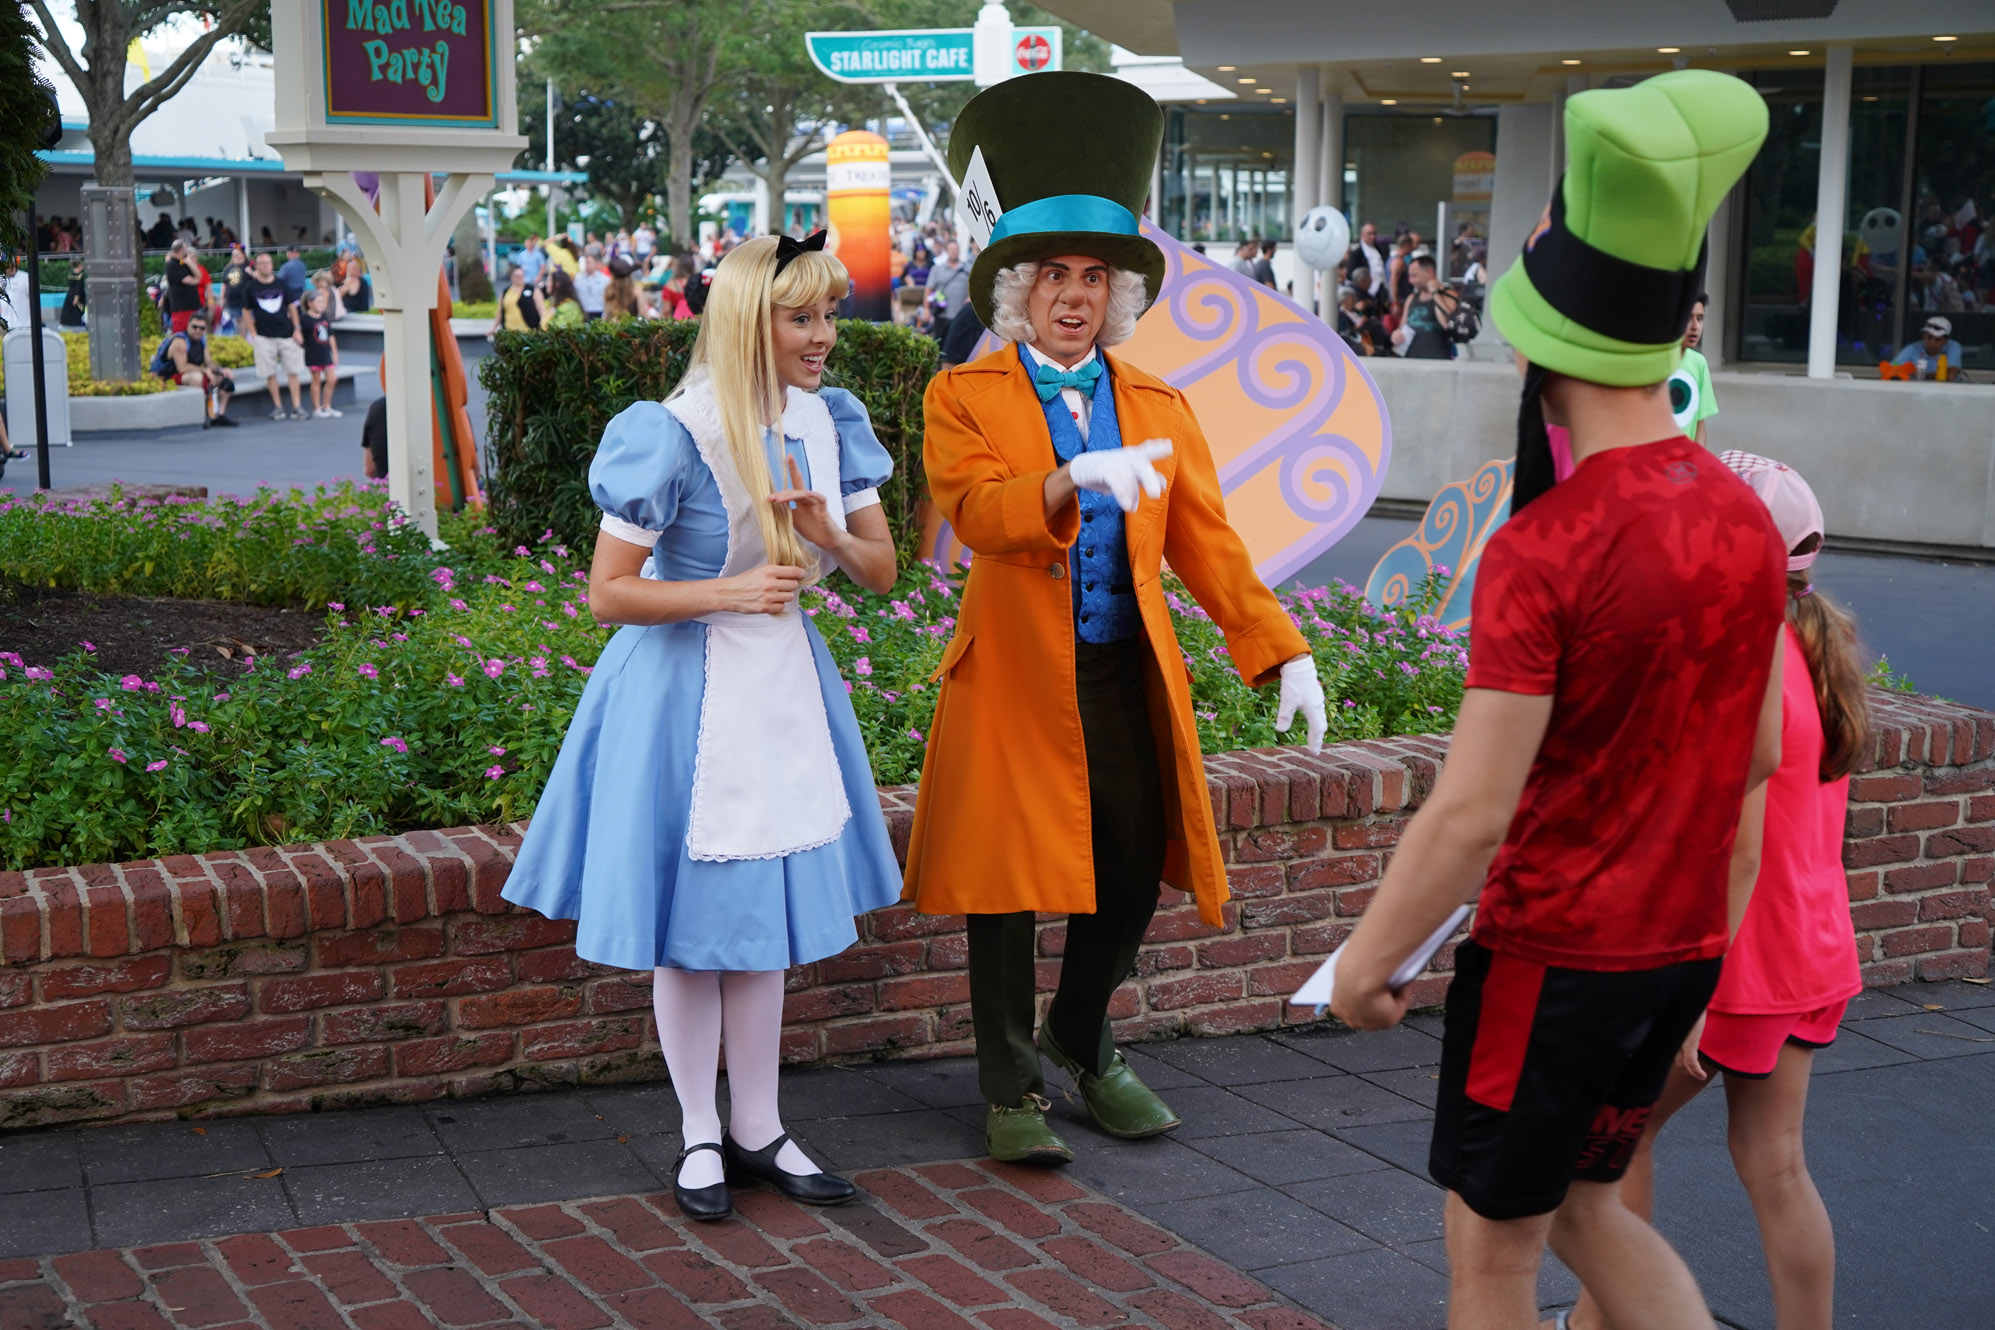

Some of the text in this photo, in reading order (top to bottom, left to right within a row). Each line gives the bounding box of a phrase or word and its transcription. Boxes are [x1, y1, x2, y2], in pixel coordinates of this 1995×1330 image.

[346, 0, 466, 36] Mad Tea
[362, 40, 449, 103] Party
[830, 47, 969, 72] STARLIGHT CAFE
